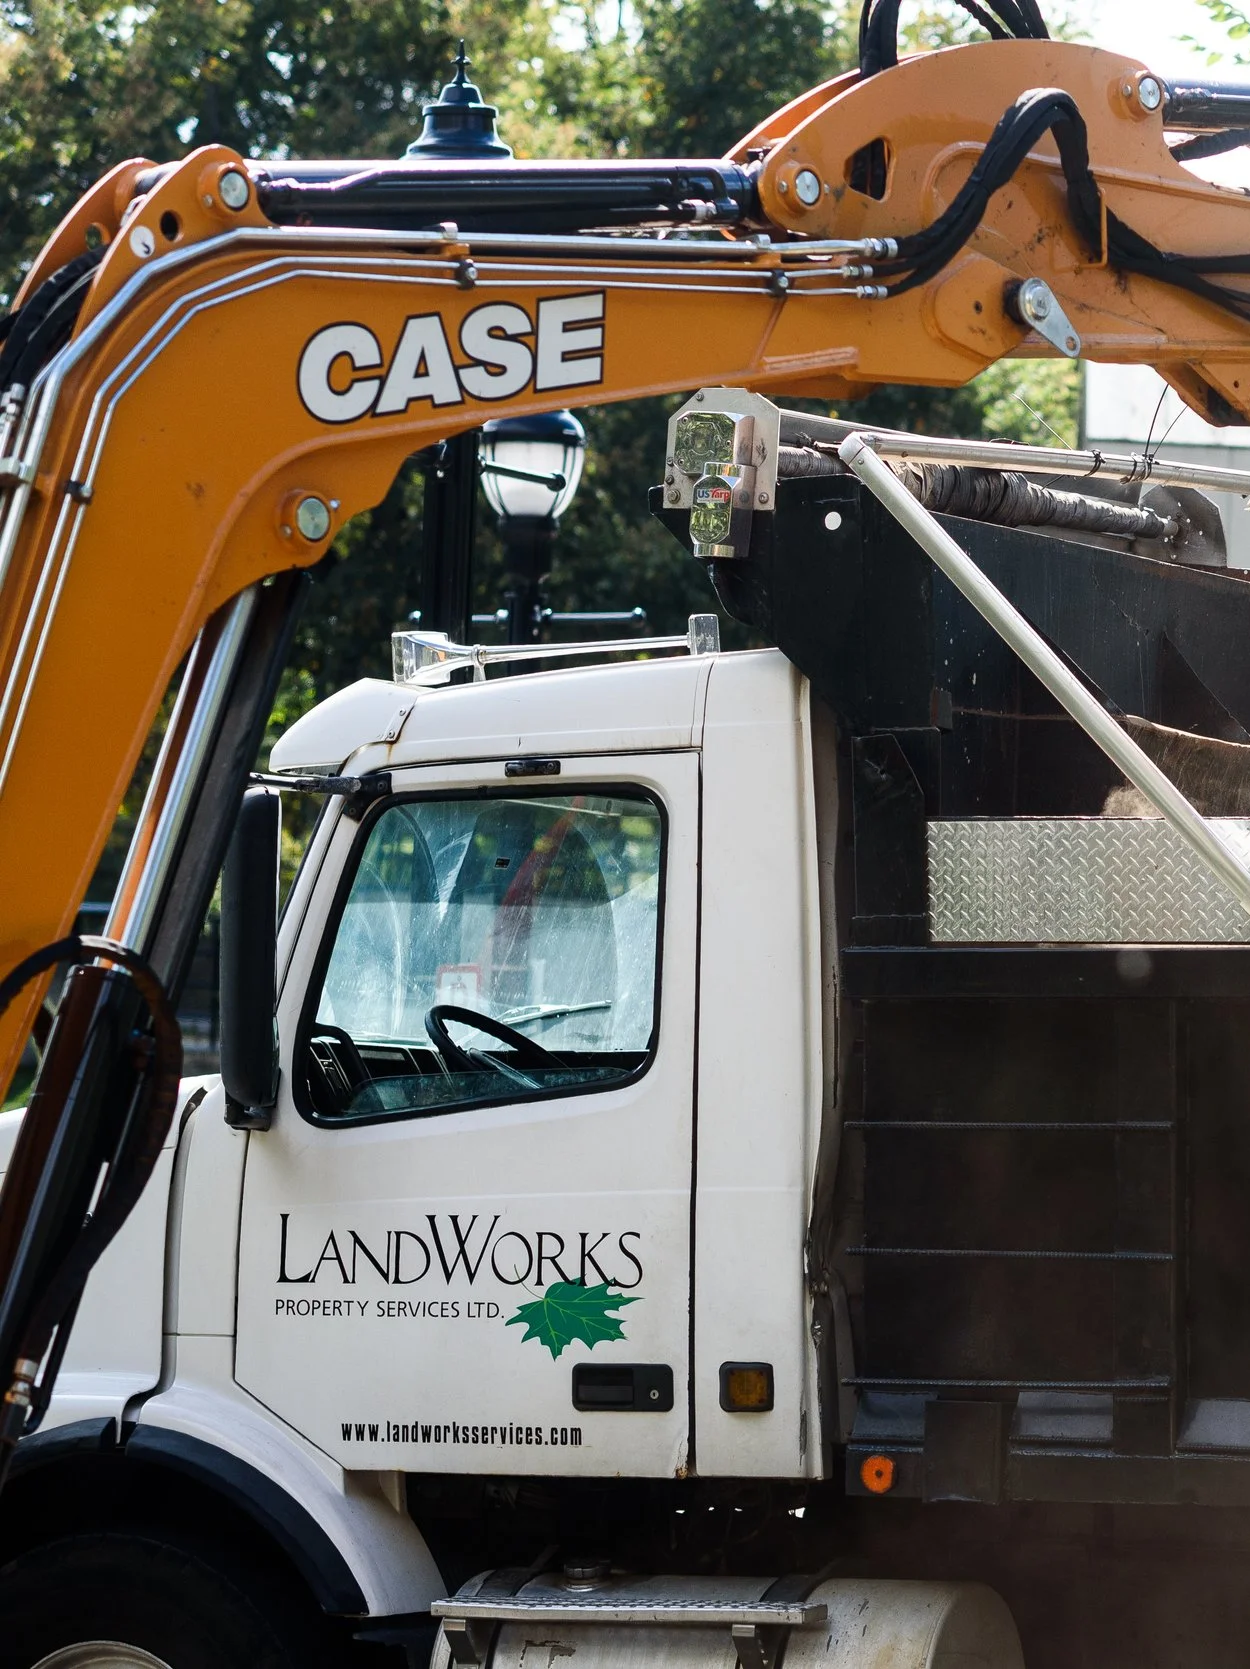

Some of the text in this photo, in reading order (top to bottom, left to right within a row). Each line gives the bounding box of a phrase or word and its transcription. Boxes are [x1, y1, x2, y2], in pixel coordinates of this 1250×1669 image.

[297, 289, 606, 425] CASE
[275, 1299, 504, 1318] PROPERTY SERVICES LTD.
[341, 1421, 582, 1446] www.landworksservices.com
